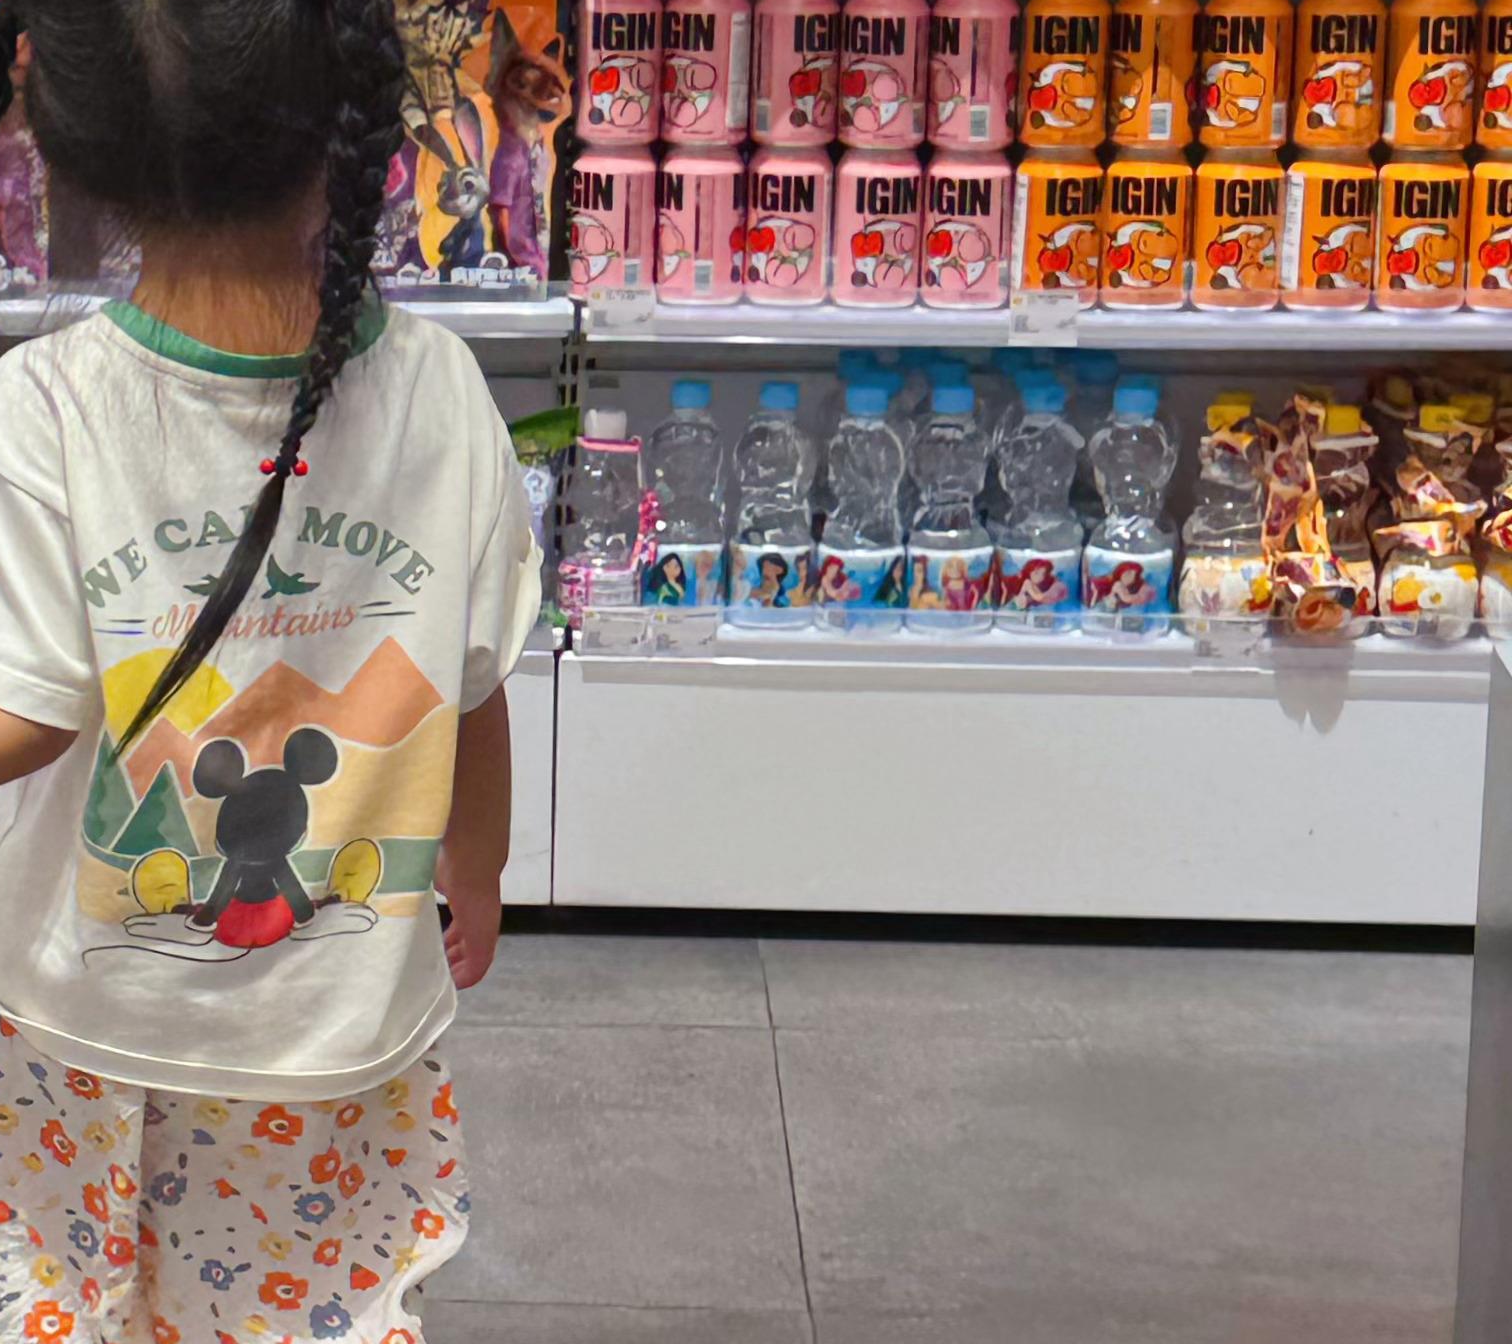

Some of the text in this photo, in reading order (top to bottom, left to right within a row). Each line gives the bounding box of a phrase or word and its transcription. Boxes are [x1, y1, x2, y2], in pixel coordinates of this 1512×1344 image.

[592, 12, 656, 51] IGIN
[1033, 15, 1100, 54] IGIN
[1311, 14, 1377, 54] IGIN
[856, 176, 919, 216] IGIN
[1112, 176, 1178, 216] IGIN
[1214, 179, 1279, 218] IGIN
[1393, 179, 1461, 219] IGIN
[82, 504, 436, 610] WE CA MOVE
